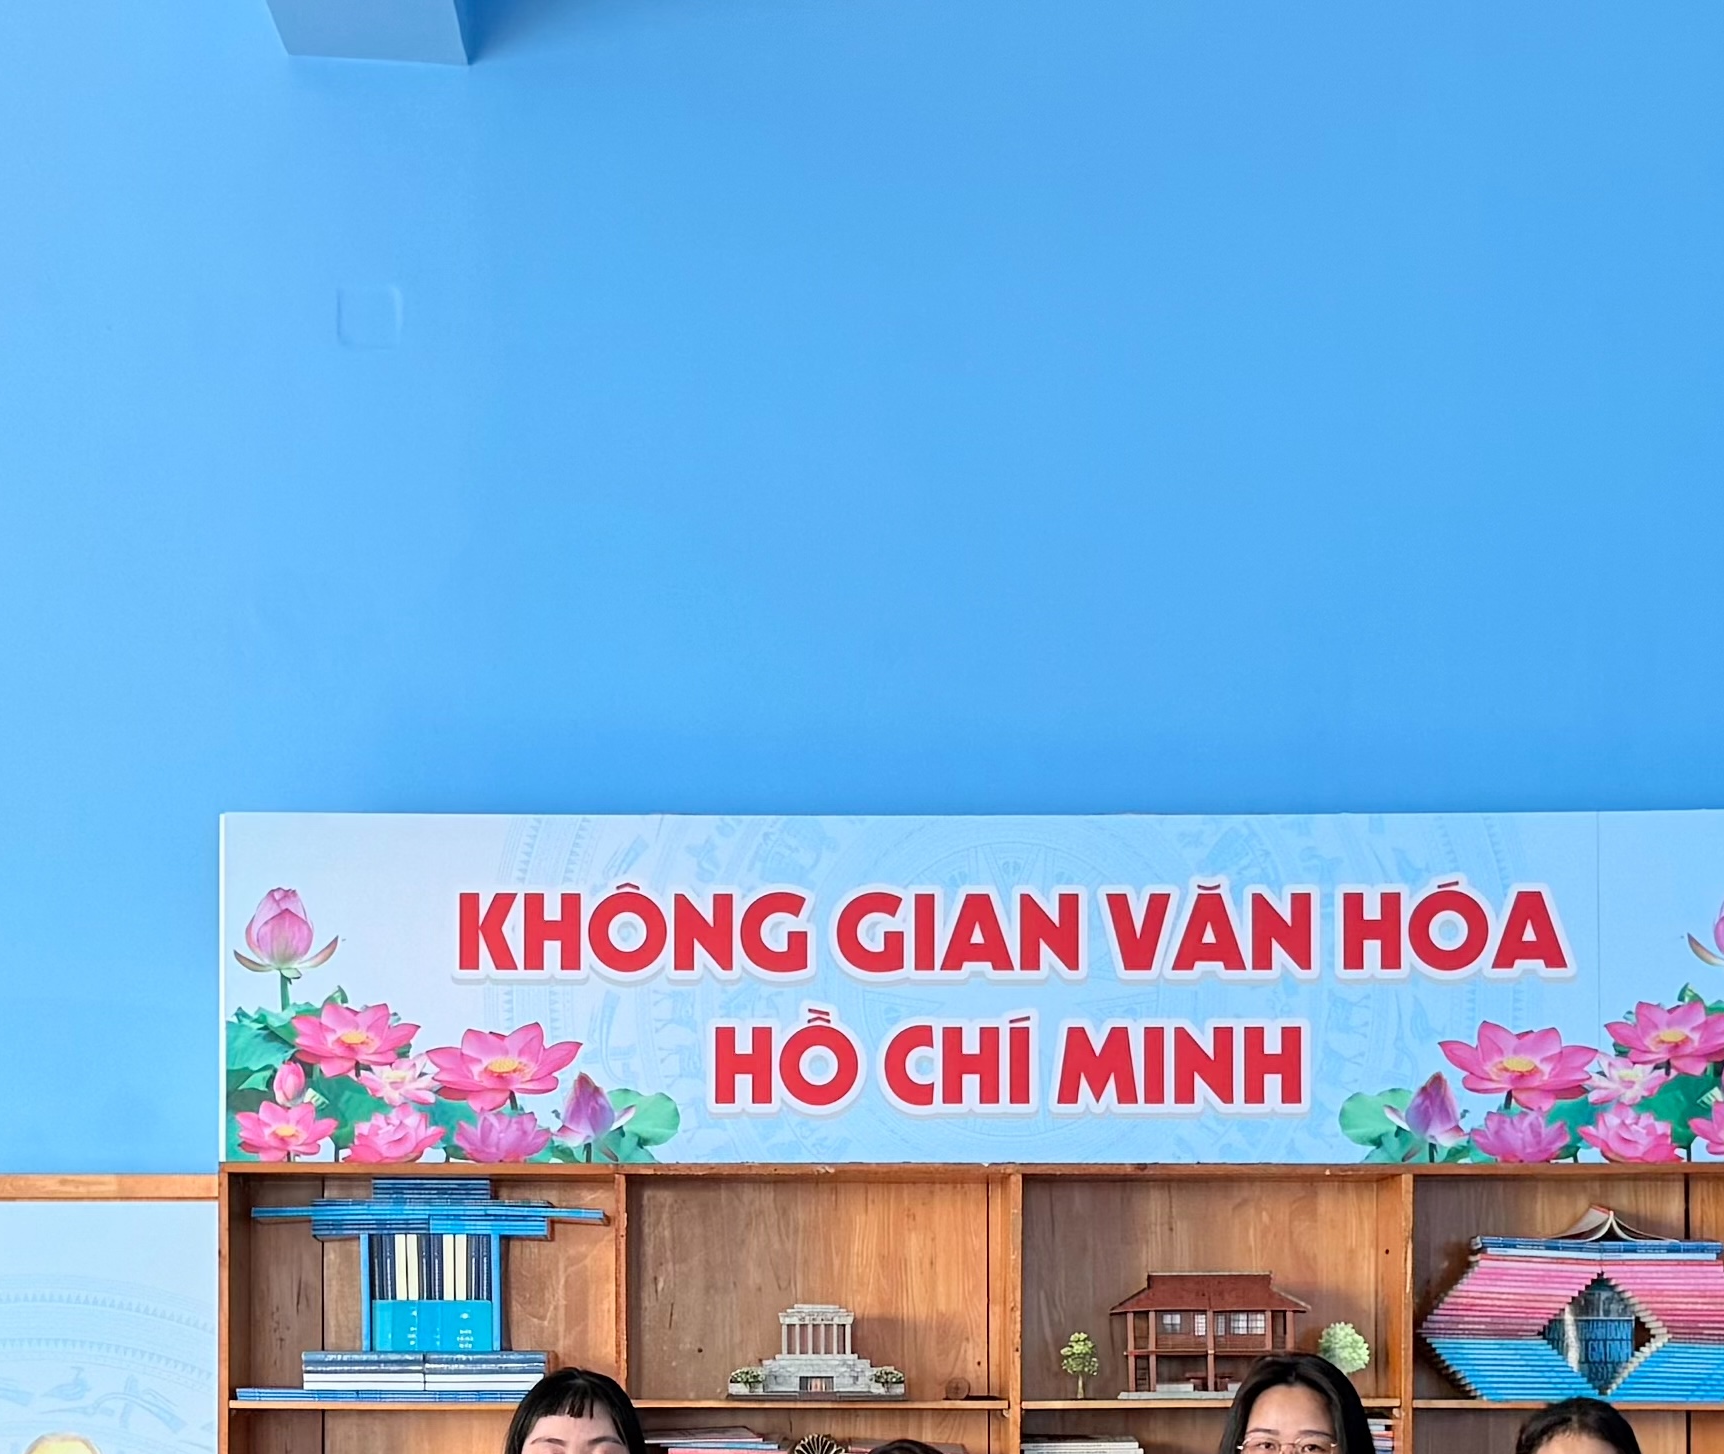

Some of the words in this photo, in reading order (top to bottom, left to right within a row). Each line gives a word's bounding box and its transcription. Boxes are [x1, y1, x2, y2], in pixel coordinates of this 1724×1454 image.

[457, 881, 809, 973] KHÔNG
[837, 892, 1079, 972] GIAN
[1106, 881, 1326, 972] VĂN
[1343, 882, 1569, 971] HÓA
[714, 1008, 860, 1107] HỒ
[883, 1014, 1034, 1107] CHÍ
[1057, 1025, 1303, 1106] MINH
